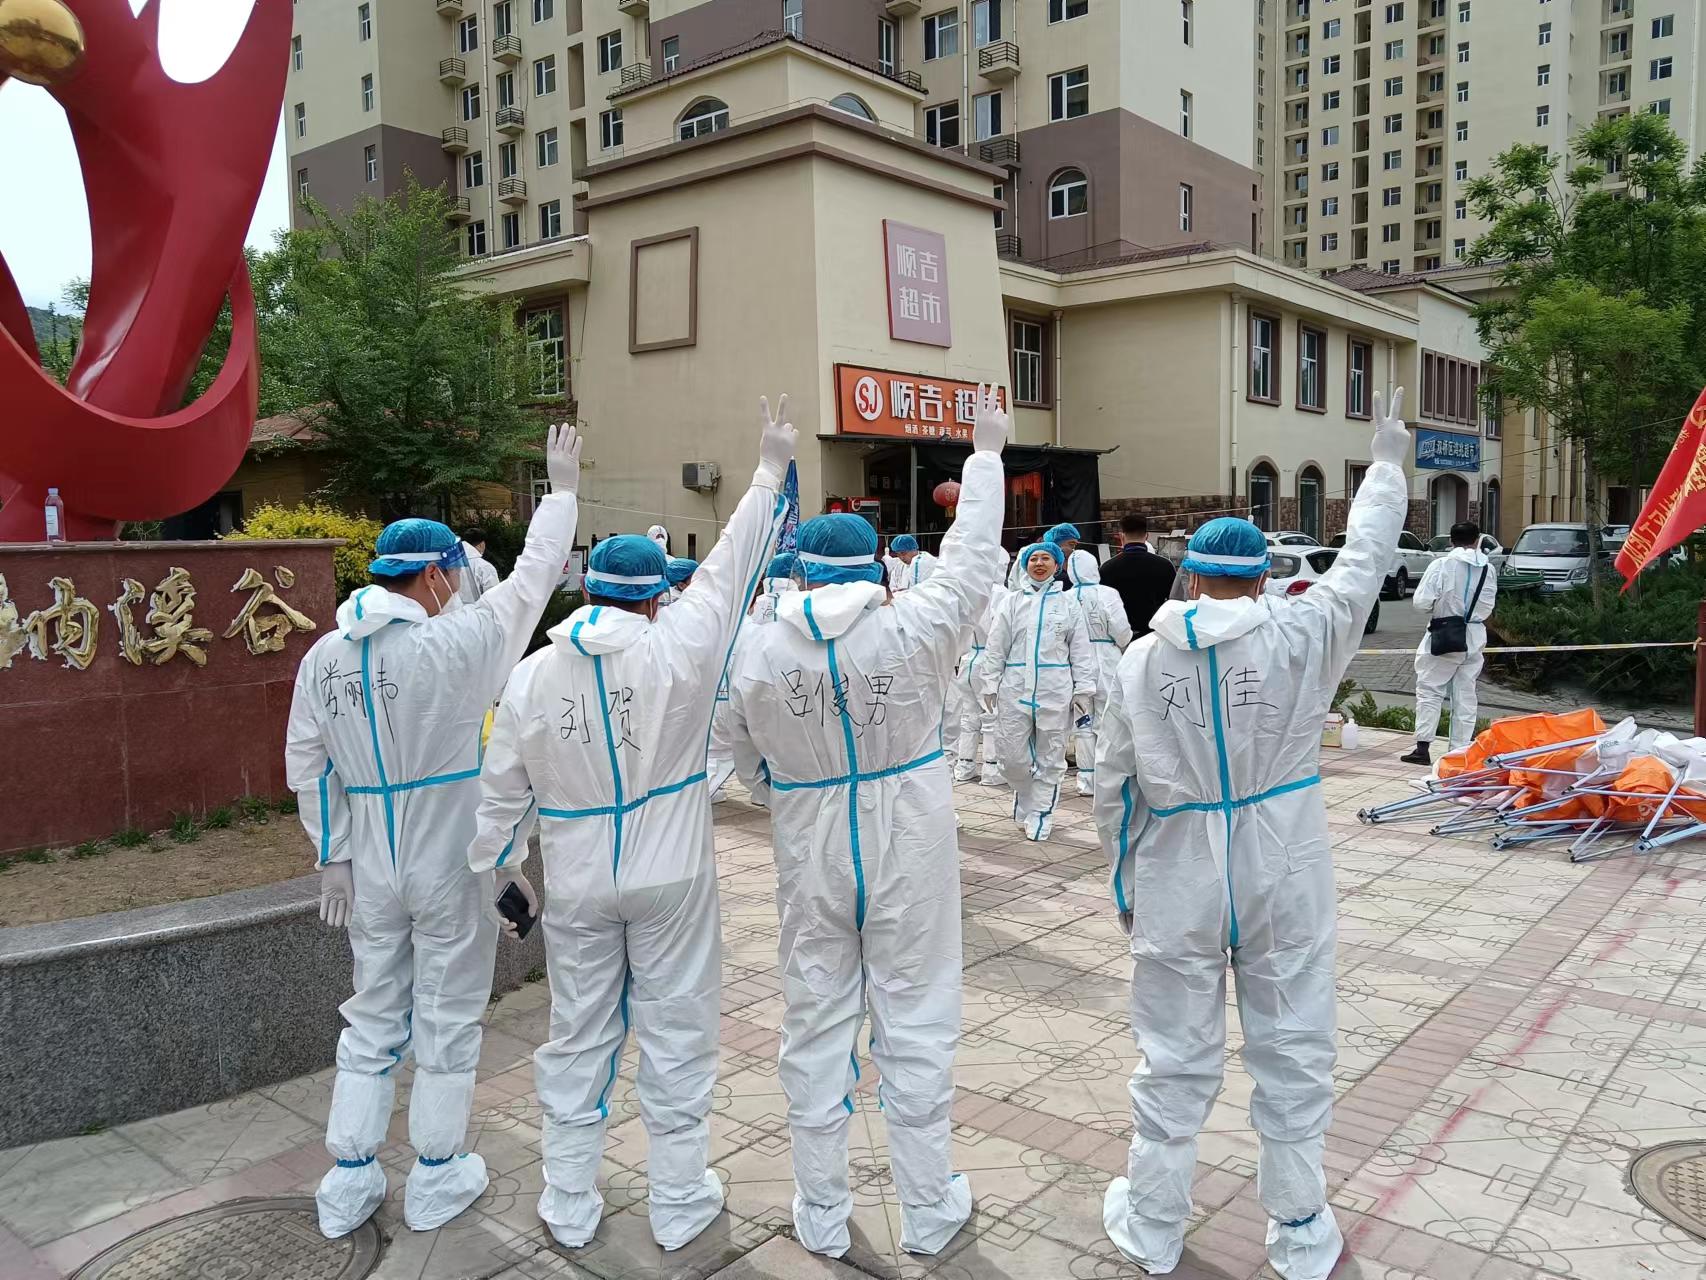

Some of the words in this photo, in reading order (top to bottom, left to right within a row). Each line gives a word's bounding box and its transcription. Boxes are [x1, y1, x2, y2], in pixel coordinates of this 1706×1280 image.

[895, 243, 940, 283] 顺吉
[898, 286, 942, 324] 超市
[858, 383, 879, 414] SJ
[1159, 664, 1280, 728] 刘佳
